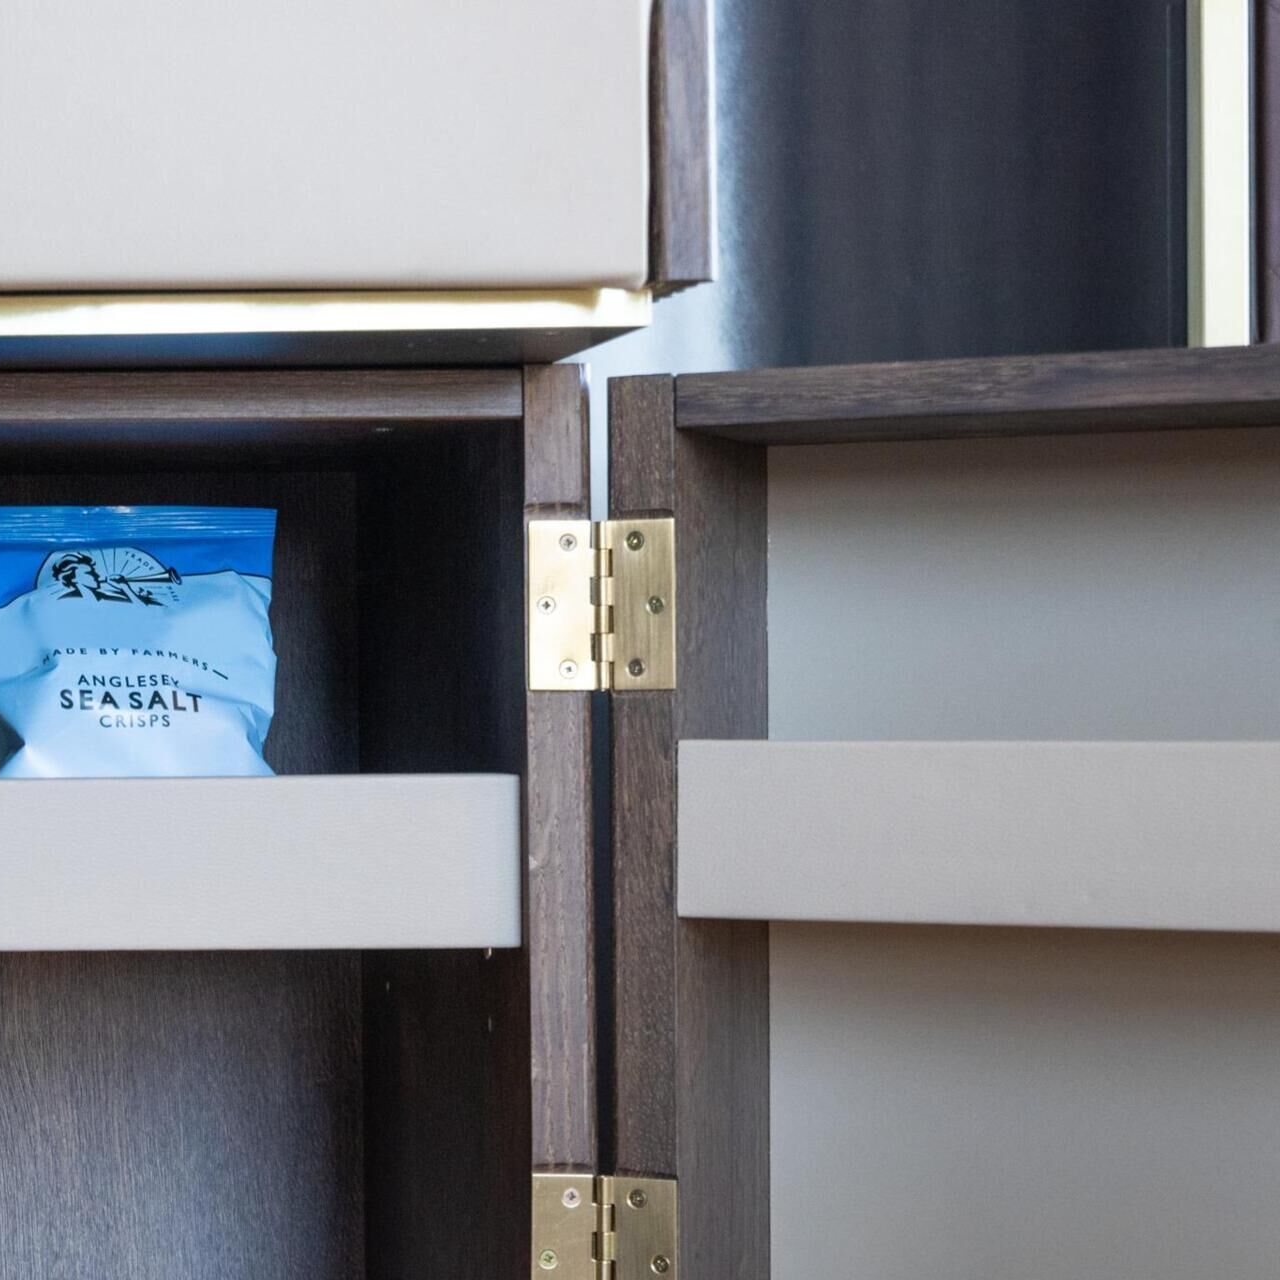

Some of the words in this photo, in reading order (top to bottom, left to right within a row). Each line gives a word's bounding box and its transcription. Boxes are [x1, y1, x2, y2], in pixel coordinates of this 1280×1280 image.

[125, 551, 155, 571] TRADE
[42, 647, 88, 666] MADE
[99, 648, 120, 656] BY
[132, 649, 208, 671] FARMERS
[77, 674, 180, 688] ANGLESEY
[60, 689, 120, 710] SEA
[128, 690, 203, 713] SALT
[99, 714, 172, 729] CRISPS
